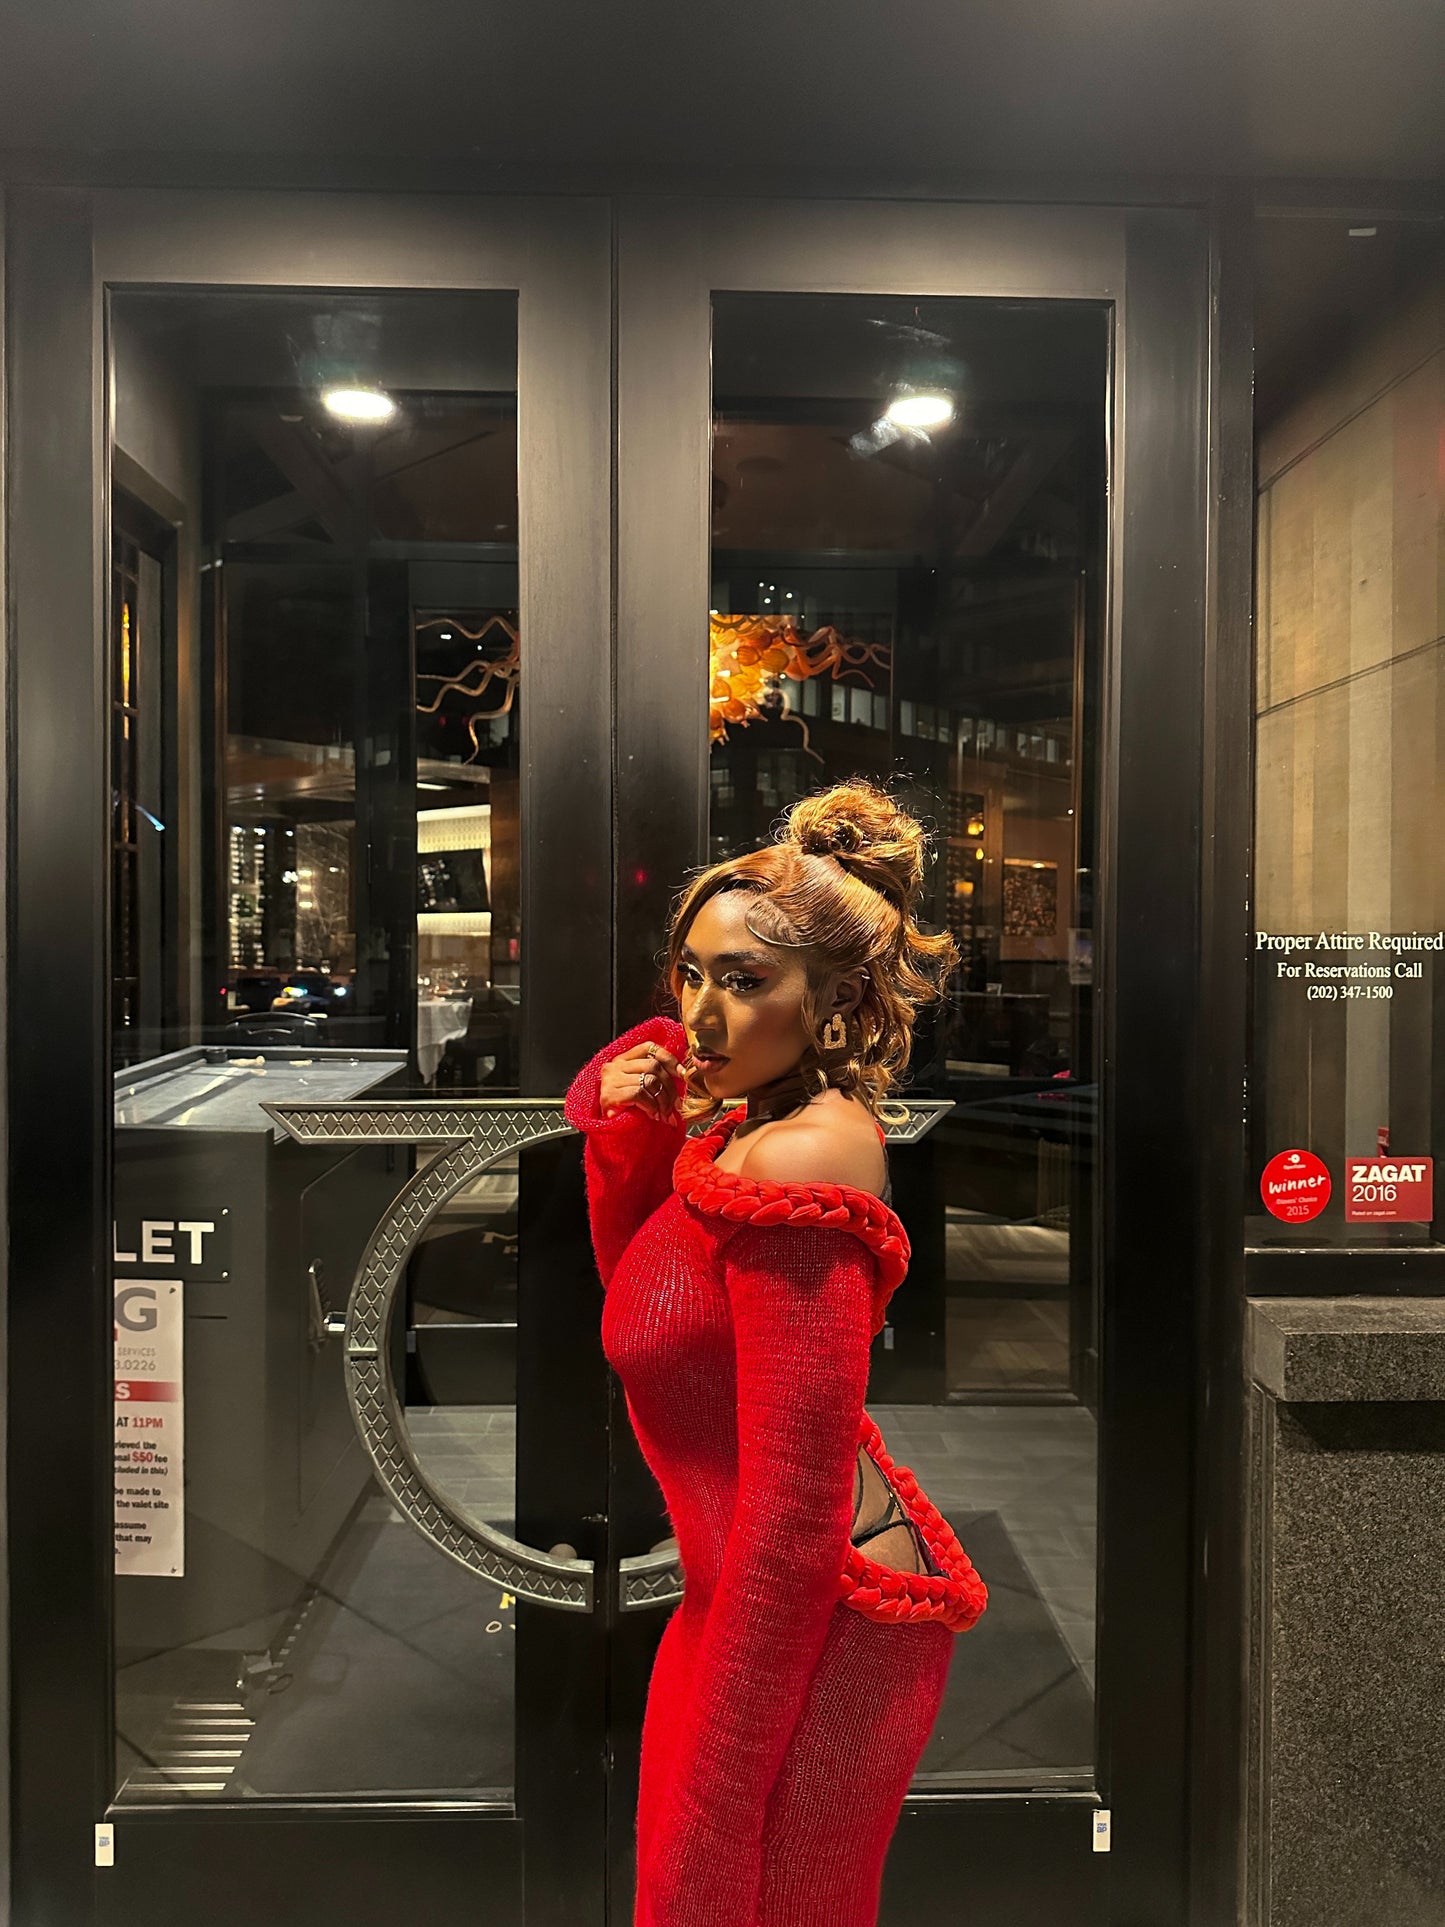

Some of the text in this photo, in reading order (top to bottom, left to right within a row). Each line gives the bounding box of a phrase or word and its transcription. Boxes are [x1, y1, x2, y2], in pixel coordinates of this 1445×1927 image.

[1256, 931, 1444, 954] Proper Attire Required
[1277, 963, 1422, 978] For Reservations Call
[1307, 986, 1393, 1001] (202) 347-1500
[1352, 1165, 1426, 1183] ZAGAT
[1269, 1175, 1326, 1195] winner
[1352, 1184, 1397, 1202] 2016
[1287, 1205, 1310, 1216] 2015
[114, 1220, 215, 1264] LET
[118, 1347, 156, 1356] SERVICES
[116, 1417, 163, 1428] AT 11PM
[132, 1451, 153, 1463] $50
[154, 1454, 168, 1463] fee
[126, 1487, 150, 1496] made
[152, 1488, 161, 1496] to
[116, 1500, 169, 1509] the valet site
[115, 1534, 152, 1544] that may
